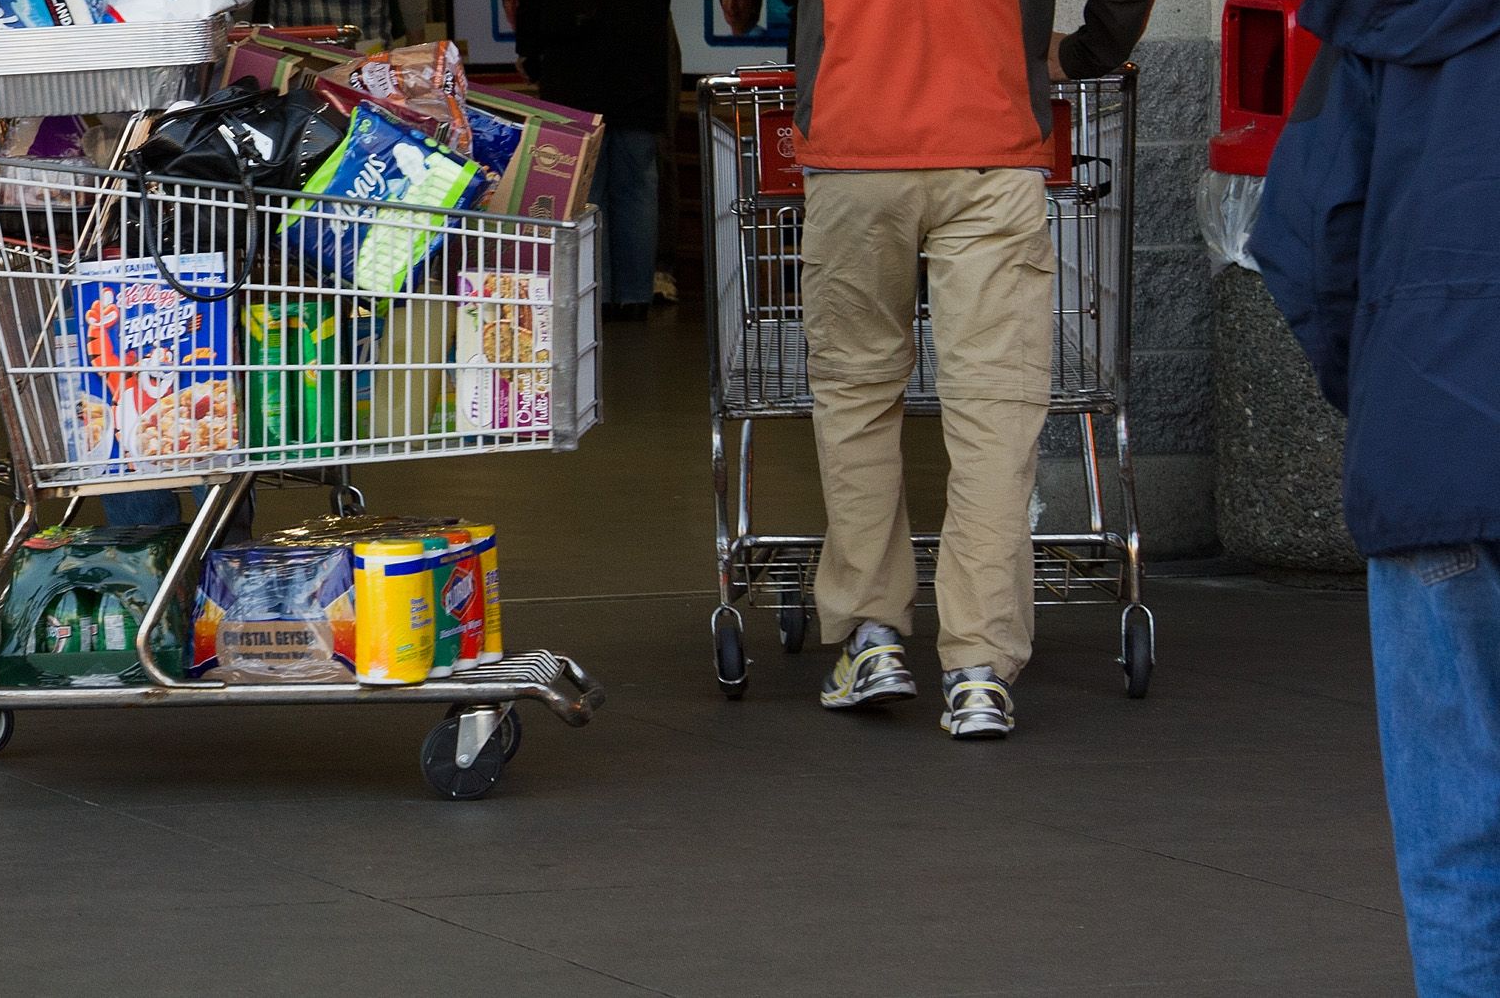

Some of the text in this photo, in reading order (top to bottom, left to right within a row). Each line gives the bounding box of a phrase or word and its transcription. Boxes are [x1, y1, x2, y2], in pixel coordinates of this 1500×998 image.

[116, 283, 187, 310] Kellogg
[516, 373, 532, 423] Original
[223, 630, 273, 646] CRYSTAL
